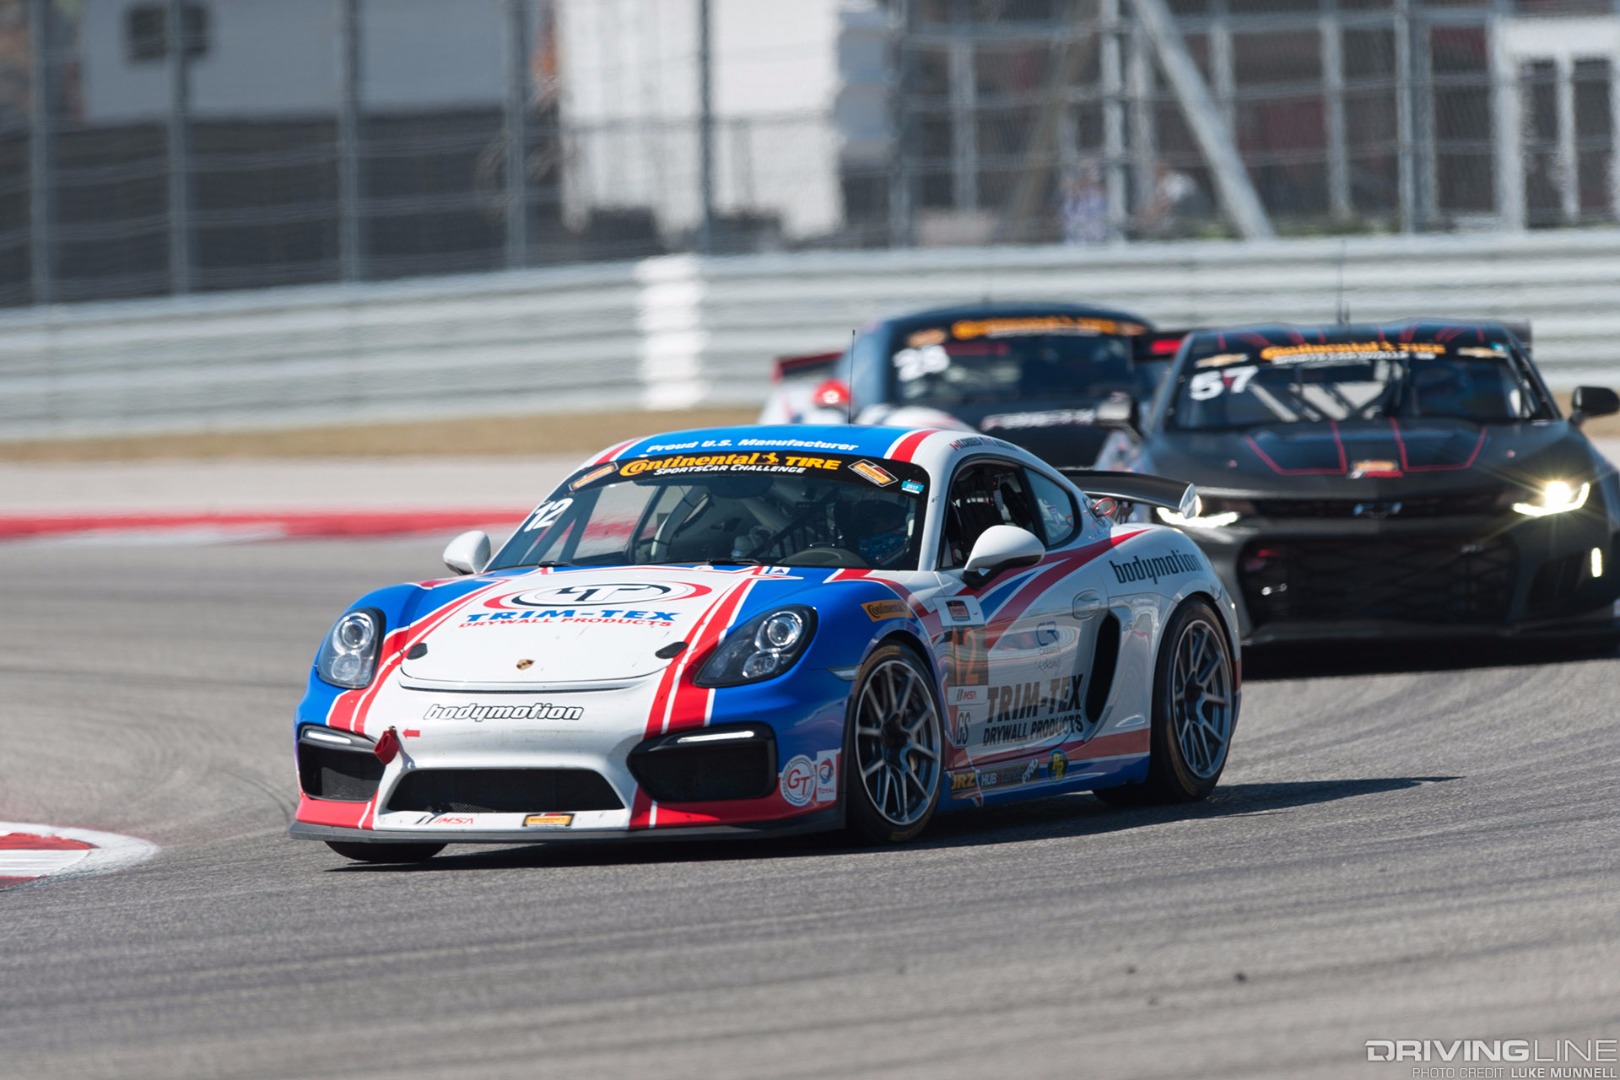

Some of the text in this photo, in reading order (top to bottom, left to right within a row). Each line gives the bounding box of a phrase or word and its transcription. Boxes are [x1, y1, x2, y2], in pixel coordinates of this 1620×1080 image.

[1190, 365, 1259, 401] 57
[646, 438, 859, 453] Proud U.S. Manufacturer
[619, 452, 842, 477] Continental TIRE
[730, 464, 807, 474] CHALLENGE
[523, 497, 574, 533] 12
[1109, 549, 1203, 585] bodymotion
[459, 617, 673, 628] DRYWALL PRODUCTS
[468, 609, 681, 622] TRIM-TEX
[987, 674, 1083, 723] TRIM-TEX
[424, 703, 584, 722] bodymotion
[983, 714, 1084, 746] DRYWALL PRODUCTS
[788, 769, 811, 796] GT
[951, 772, 976, 790] JRZ
